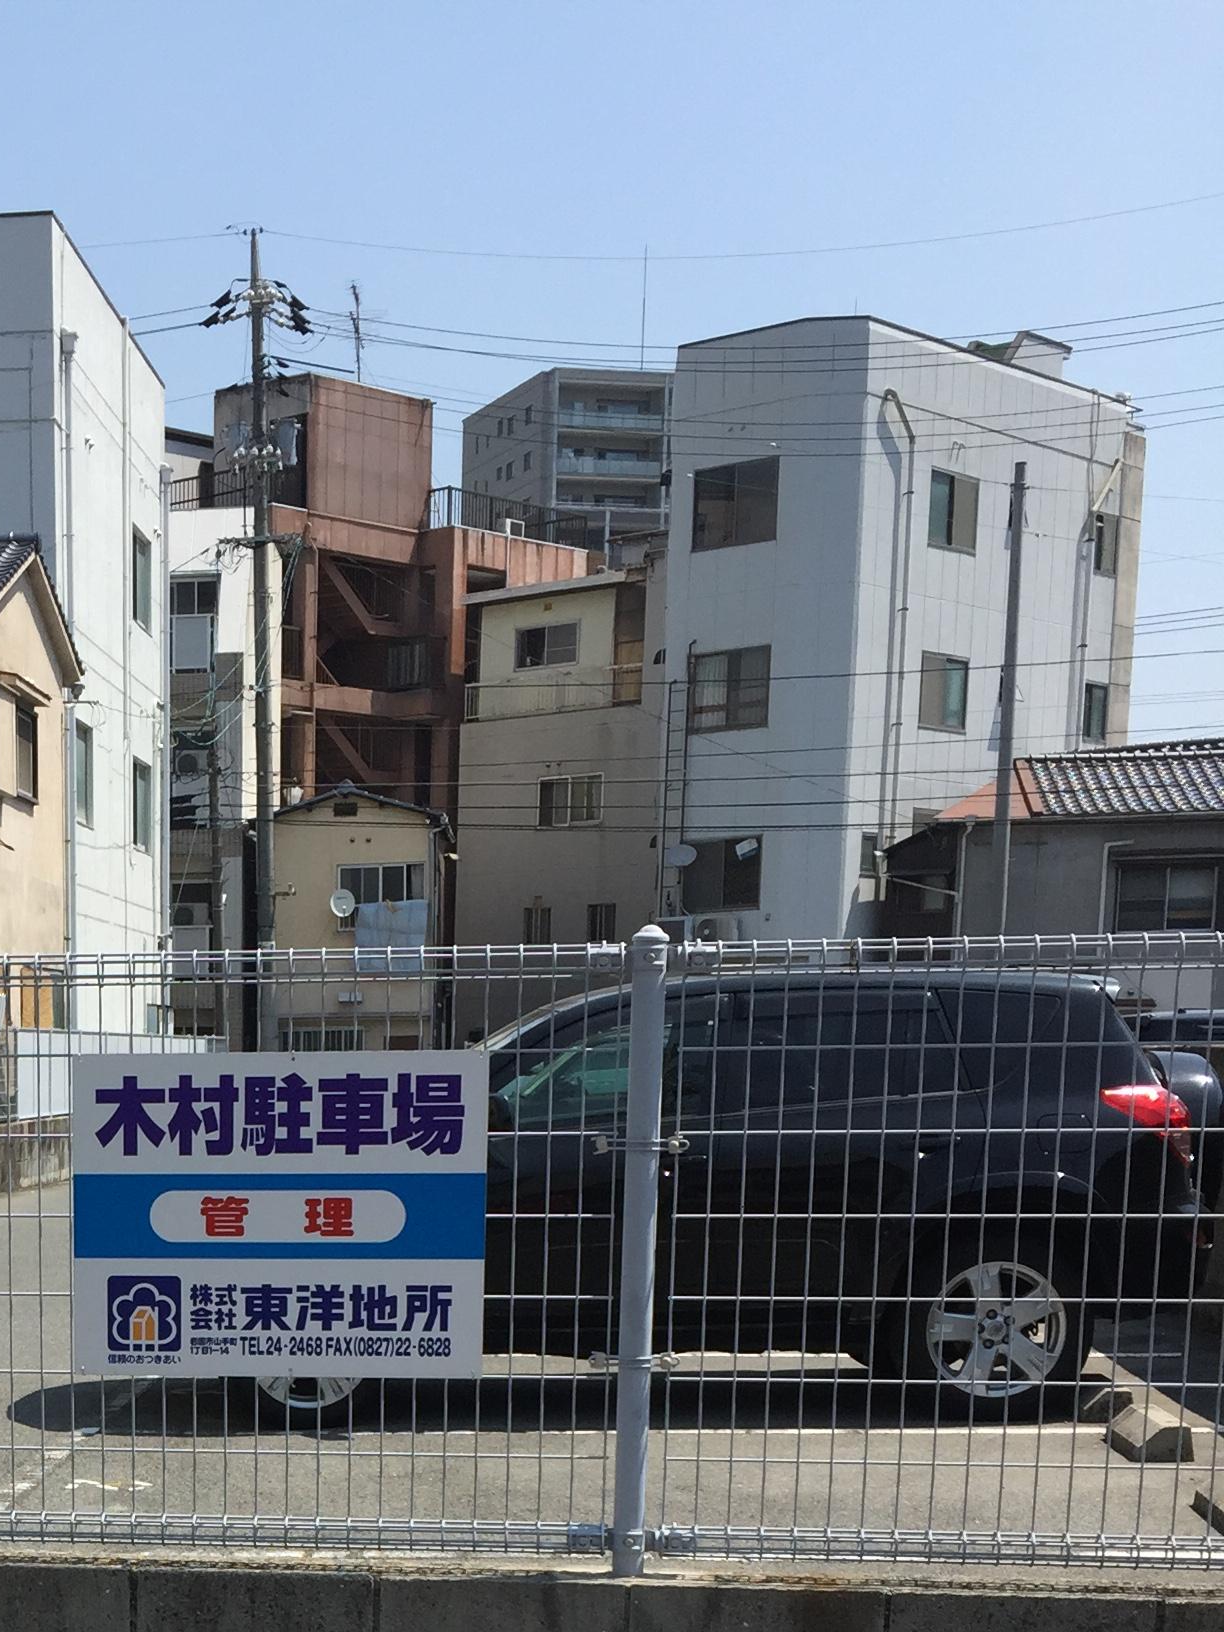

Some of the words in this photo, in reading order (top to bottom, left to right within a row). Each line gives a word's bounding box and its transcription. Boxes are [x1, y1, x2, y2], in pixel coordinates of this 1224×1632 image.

[94, 1072, 466, 1157] 木村駐車場
[240, 1284, 453, 1332] 東洋地所
[107, 1353, 182, 1364] 信頼のおつきあい
